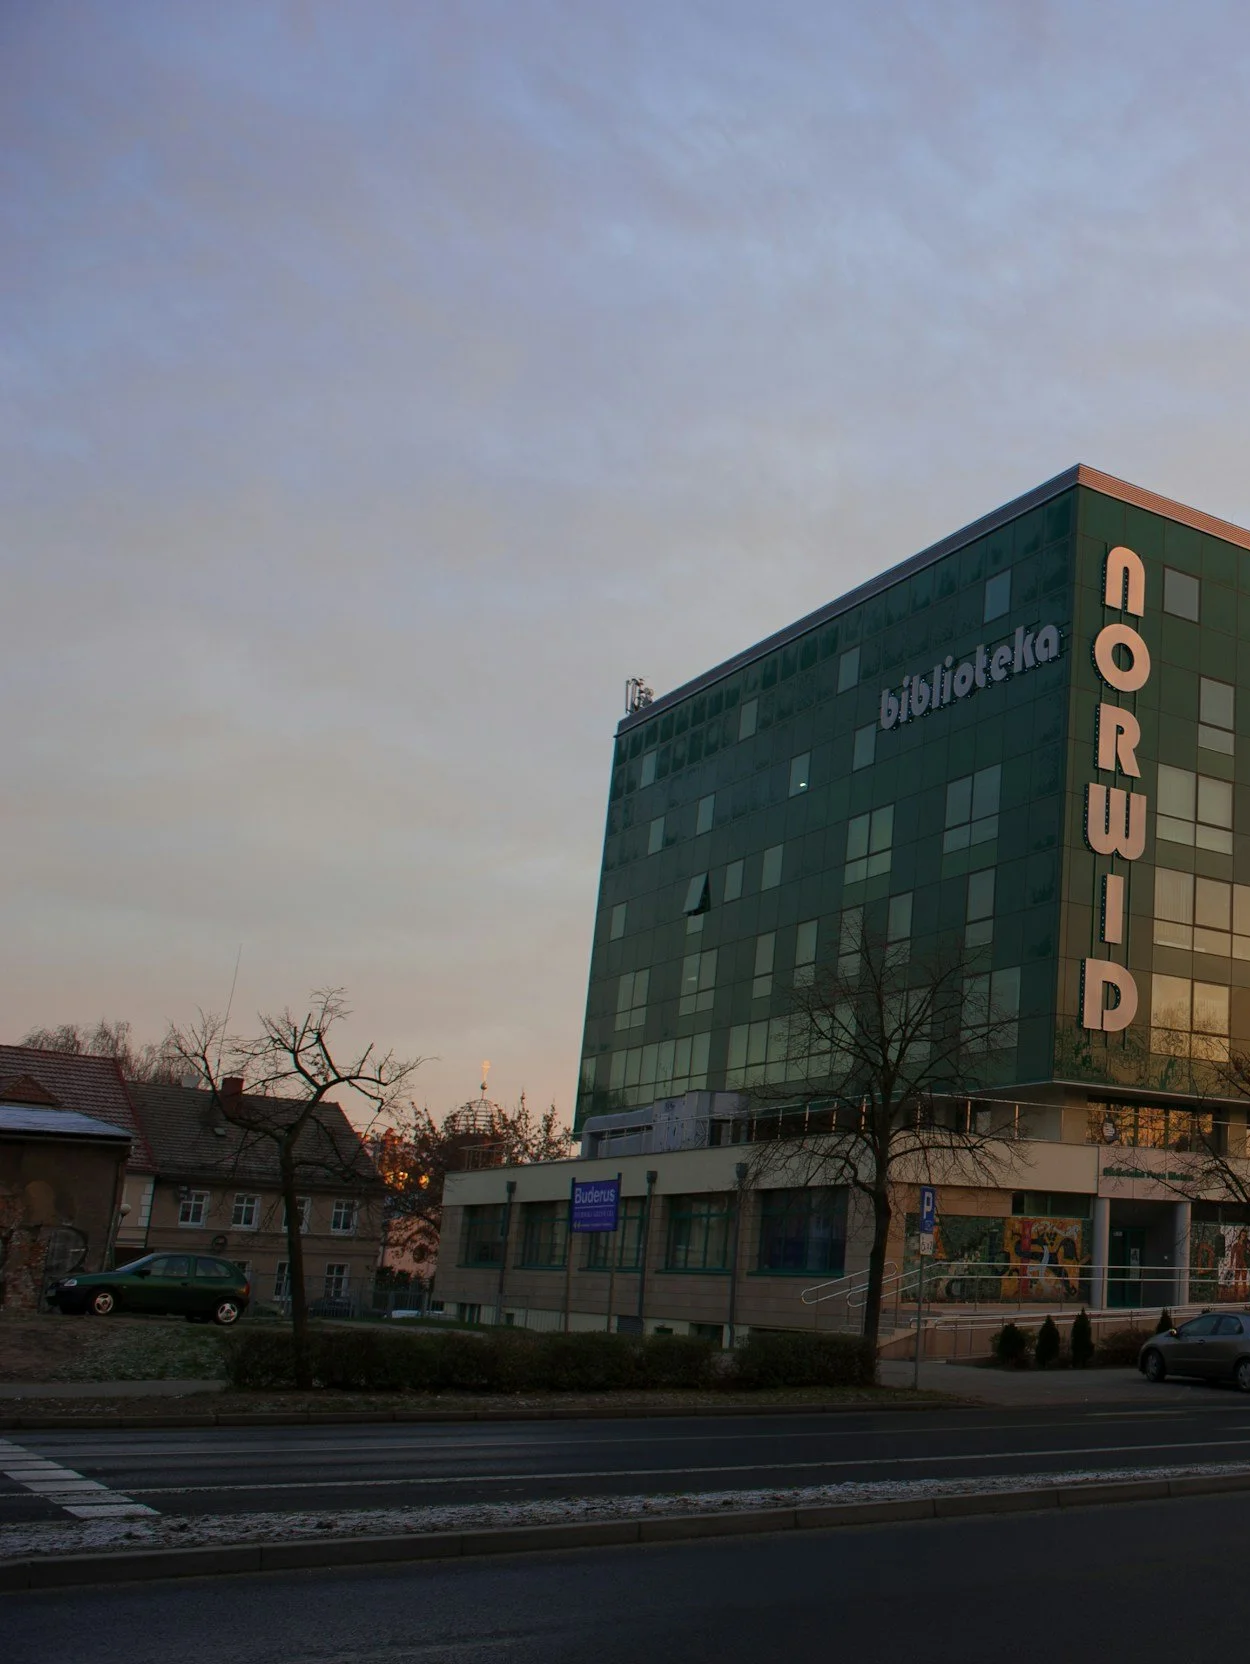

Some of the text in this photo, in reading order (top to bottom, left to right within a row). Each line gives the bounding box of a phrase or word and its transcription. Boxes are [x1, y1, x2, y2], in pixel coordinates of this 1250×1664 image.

[879, 623, 1062, 732] biblioteka
[574, 1186, 616, 1204] Buderus
[923, 1191, 933, 1219] P
